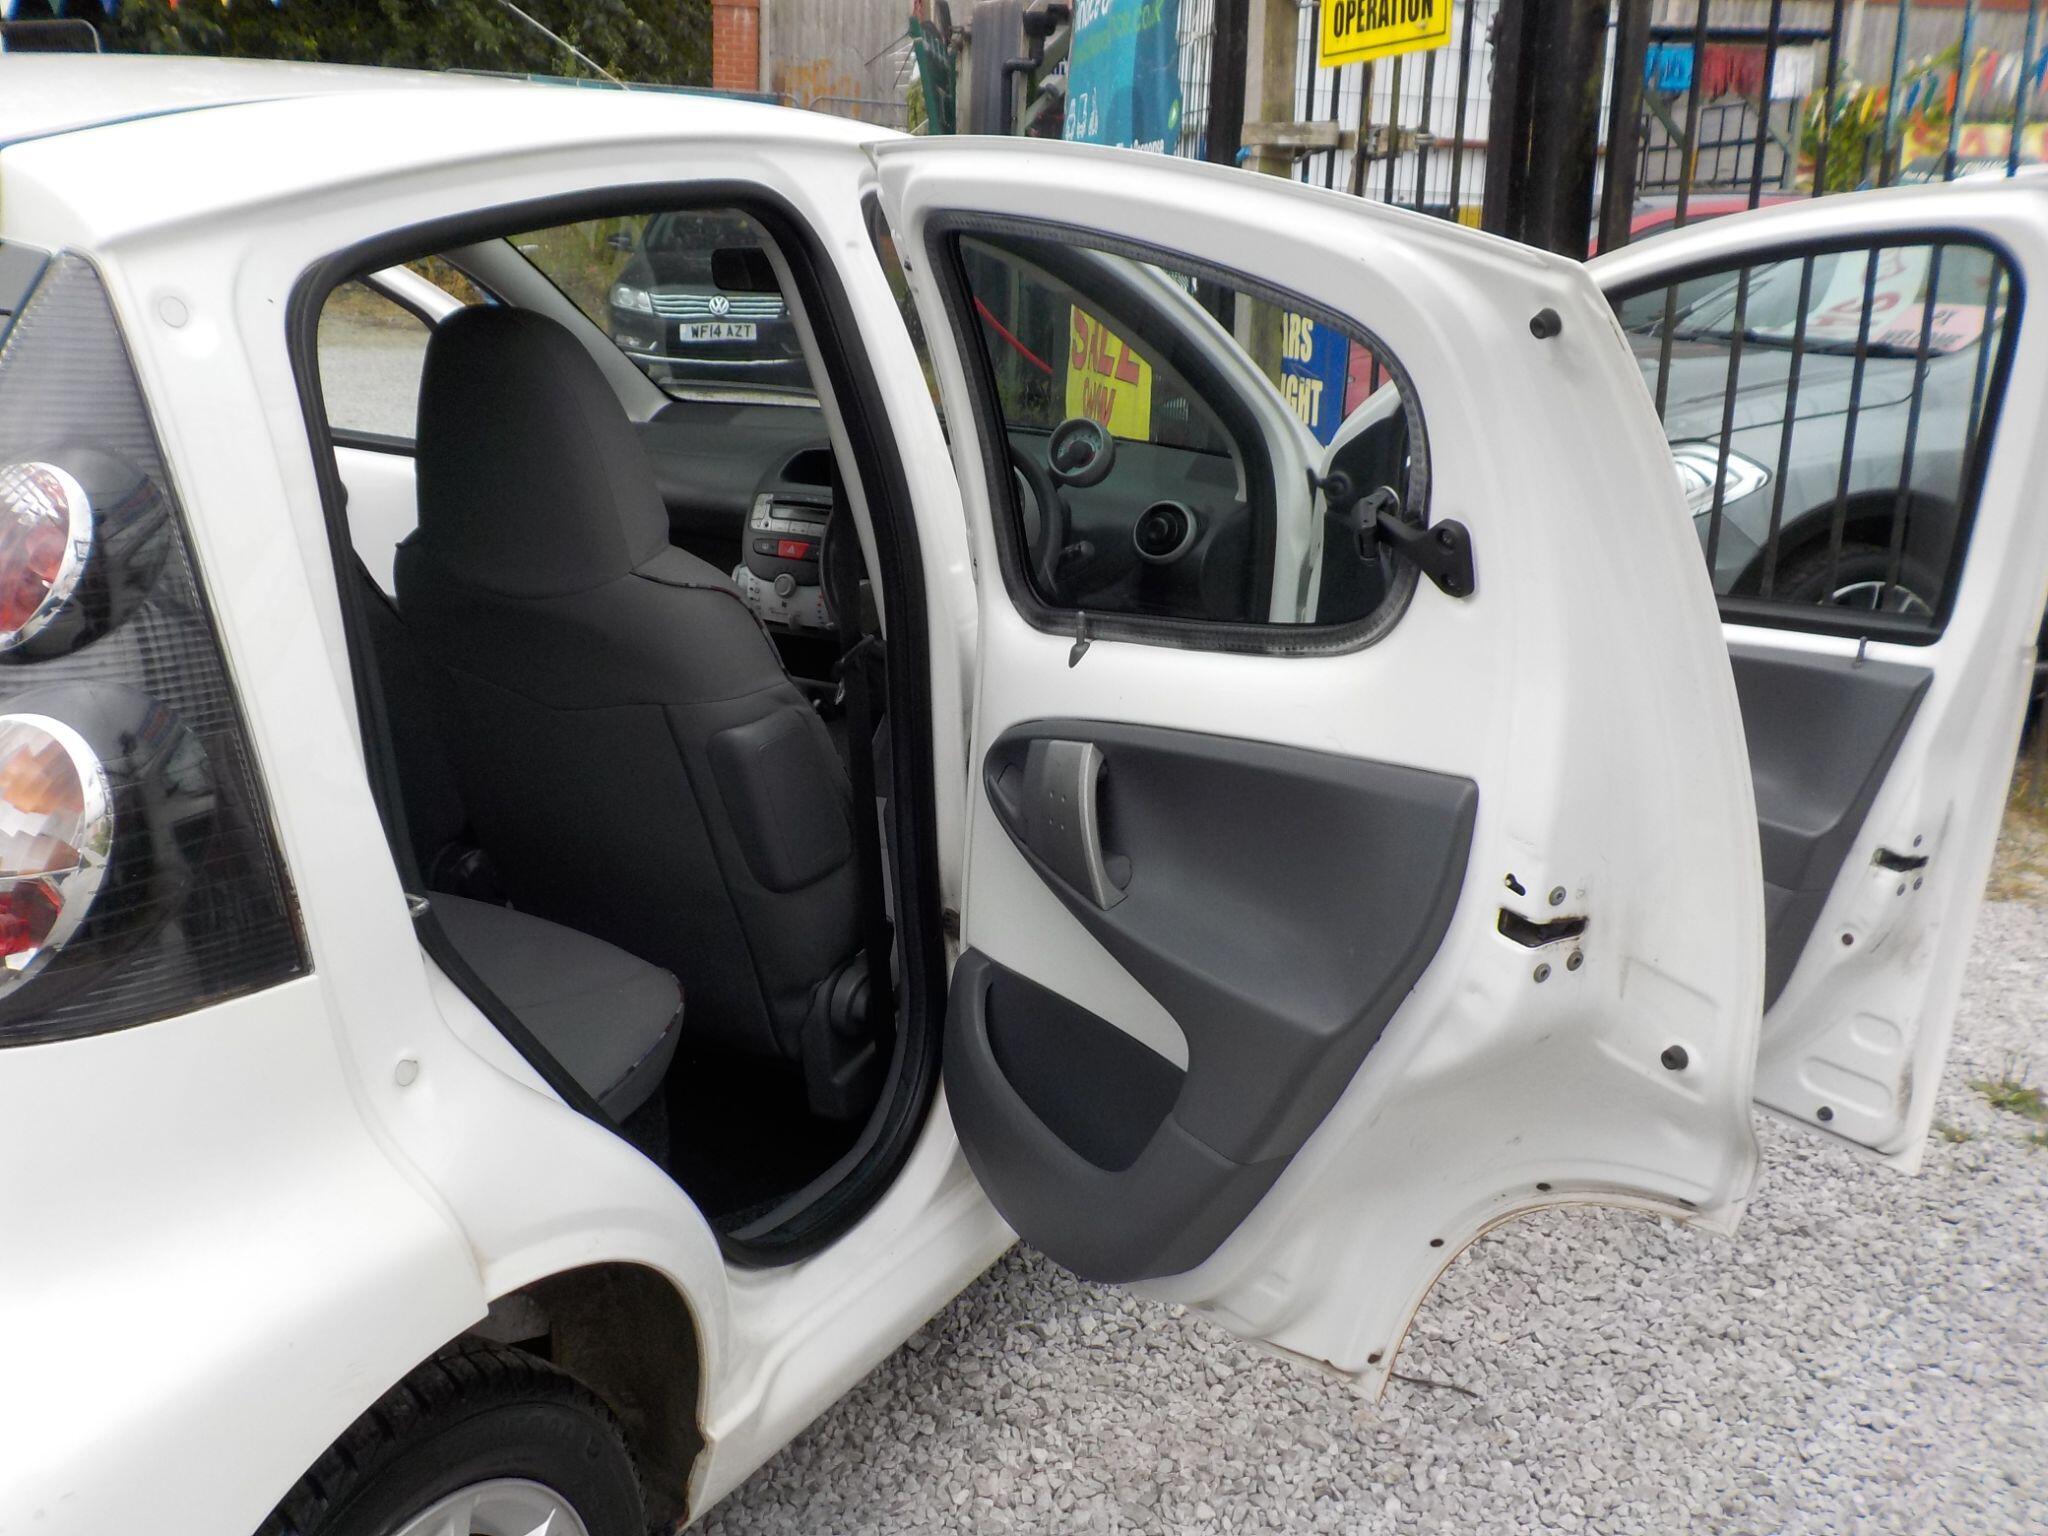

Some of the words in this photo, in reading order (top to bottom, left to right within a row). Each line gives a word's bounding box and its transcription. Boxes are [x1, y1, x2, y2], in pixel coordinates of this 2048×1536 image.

[1333, 0, 1433, 38] OPERATION
[691, 325, 722, 338] WF14
[727, 324, 752, 338] AZT
